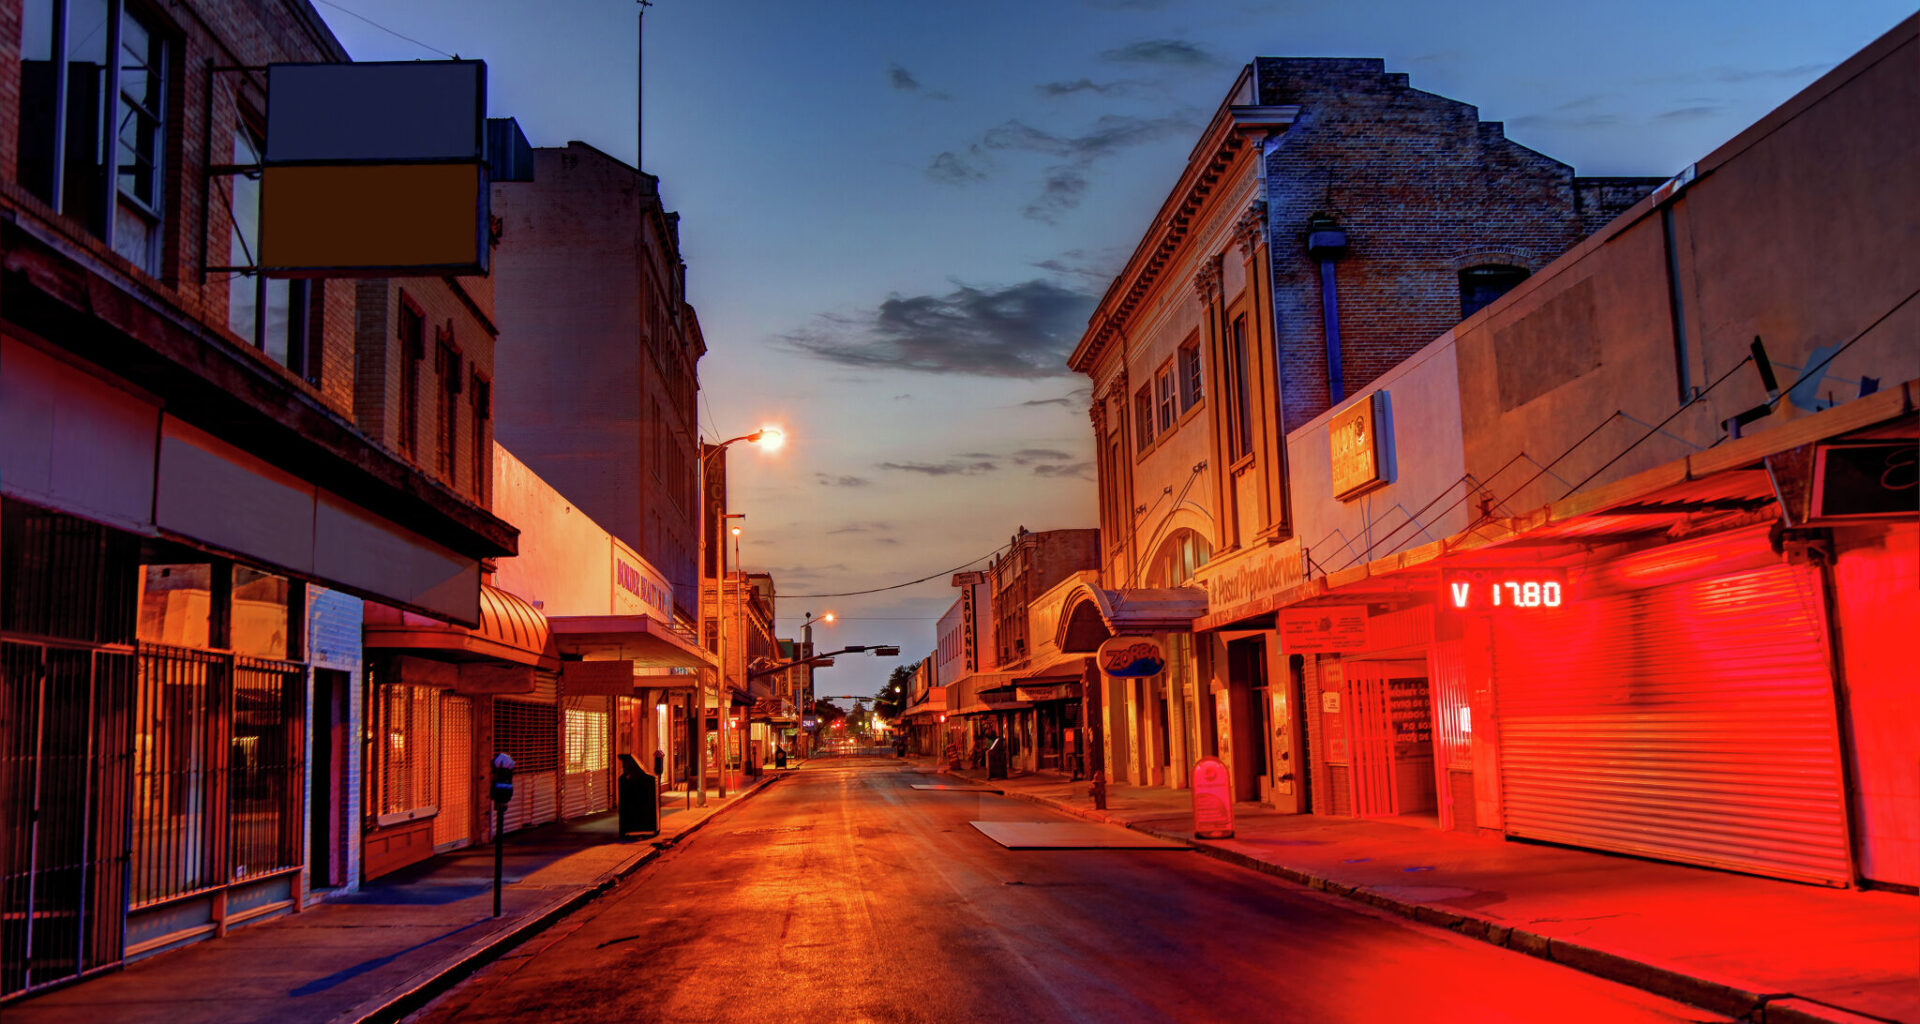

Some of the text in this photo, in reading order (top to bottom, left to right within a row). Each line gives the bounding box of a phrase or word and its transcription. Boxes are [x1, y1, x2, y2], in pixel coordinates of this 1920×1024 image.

[1451, 582, 1561, 607] V 17.80
[963, 589, 973, 671] SAVANNA
[1104, 643, 1161, 670] ZORBA
